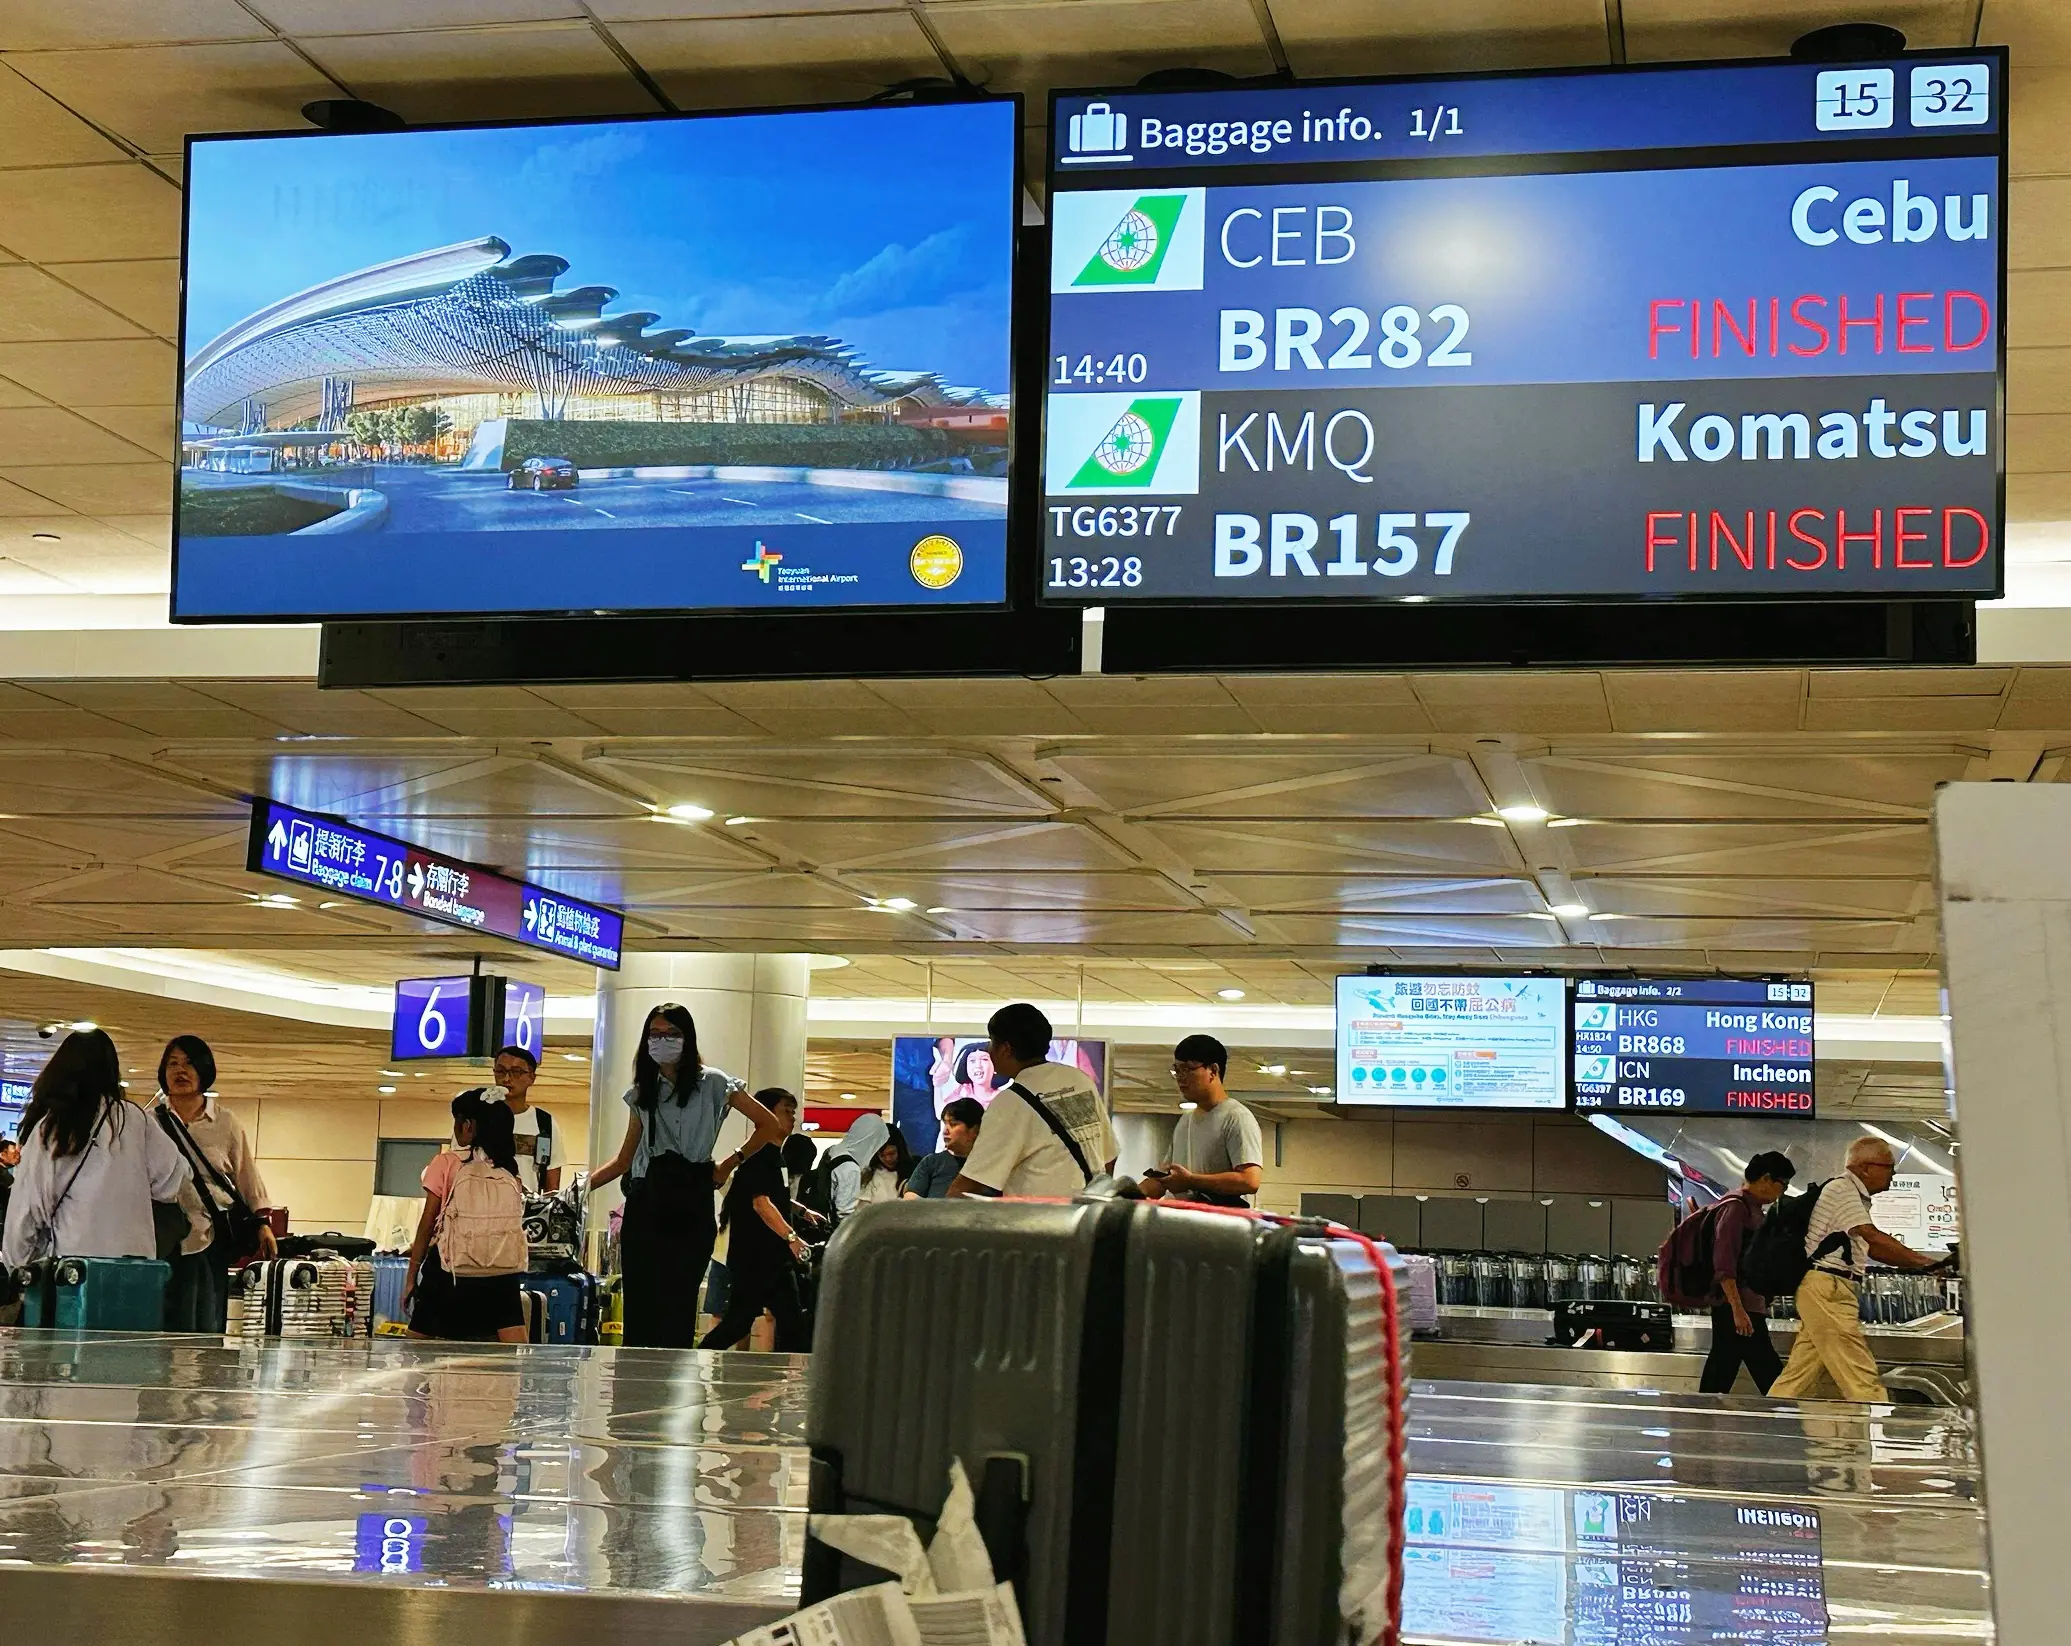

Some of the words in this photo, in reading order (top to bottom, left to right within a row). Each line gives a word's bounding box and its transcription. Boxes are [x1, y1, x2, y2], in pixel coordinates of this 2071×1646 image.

[1140, 118, 1293, 156] Baggage
[1303, 107, 1382, 143] info.
[1409, 105, 1464, 142] 1/1
[1791, 179, 1989, 247] Cebu
[1221, 205, 1356, 269] CEB
[1219, 304, 1473, 372] BR282
[1648, 290, 1992, 359] FINISHED
[1053, 353, 1148, 385] 14:40
[1218, 409, 1375, 484] KMQ
[1637, 398, 1988, 463] Komatsu
[1048, 505, 1183, 537] TG6377
[1214, 512, 1471, 577] BR157
[1644, 505, 1990, 573] FINISHED
[829, 574, 859, 584] Airport
[1048, 556, 1143, 588] 13:28
[314, 828, 367, 867] 提領行李
[311, 858, 350, 888] Baggage
[374, 854, 403, 900] 7-8
[1597, 984, 1638, 998] Baggage
[1665, 985, 1684, 997] 2/2
[418, 984, 447, 1051] 6
[516, 991, 534, 1051] 6
[1618, 1008, 1658, 1027] HKG
[1706, 1011, 1758, 1032] Hong
[1761, 1012, 1812, 1034] Kong
[1618, 1034, 1686, 1055] BR868
[1726, 1039, 1812, 1057] FINISHED
[1618, 1061, 1650, 1079] ICN
[1733, 1063, 1812, 1083] Incheon
[1618, 1086, 1686, 1107] BR169
[1726, 1090, 1812, 1110] FINISHED
